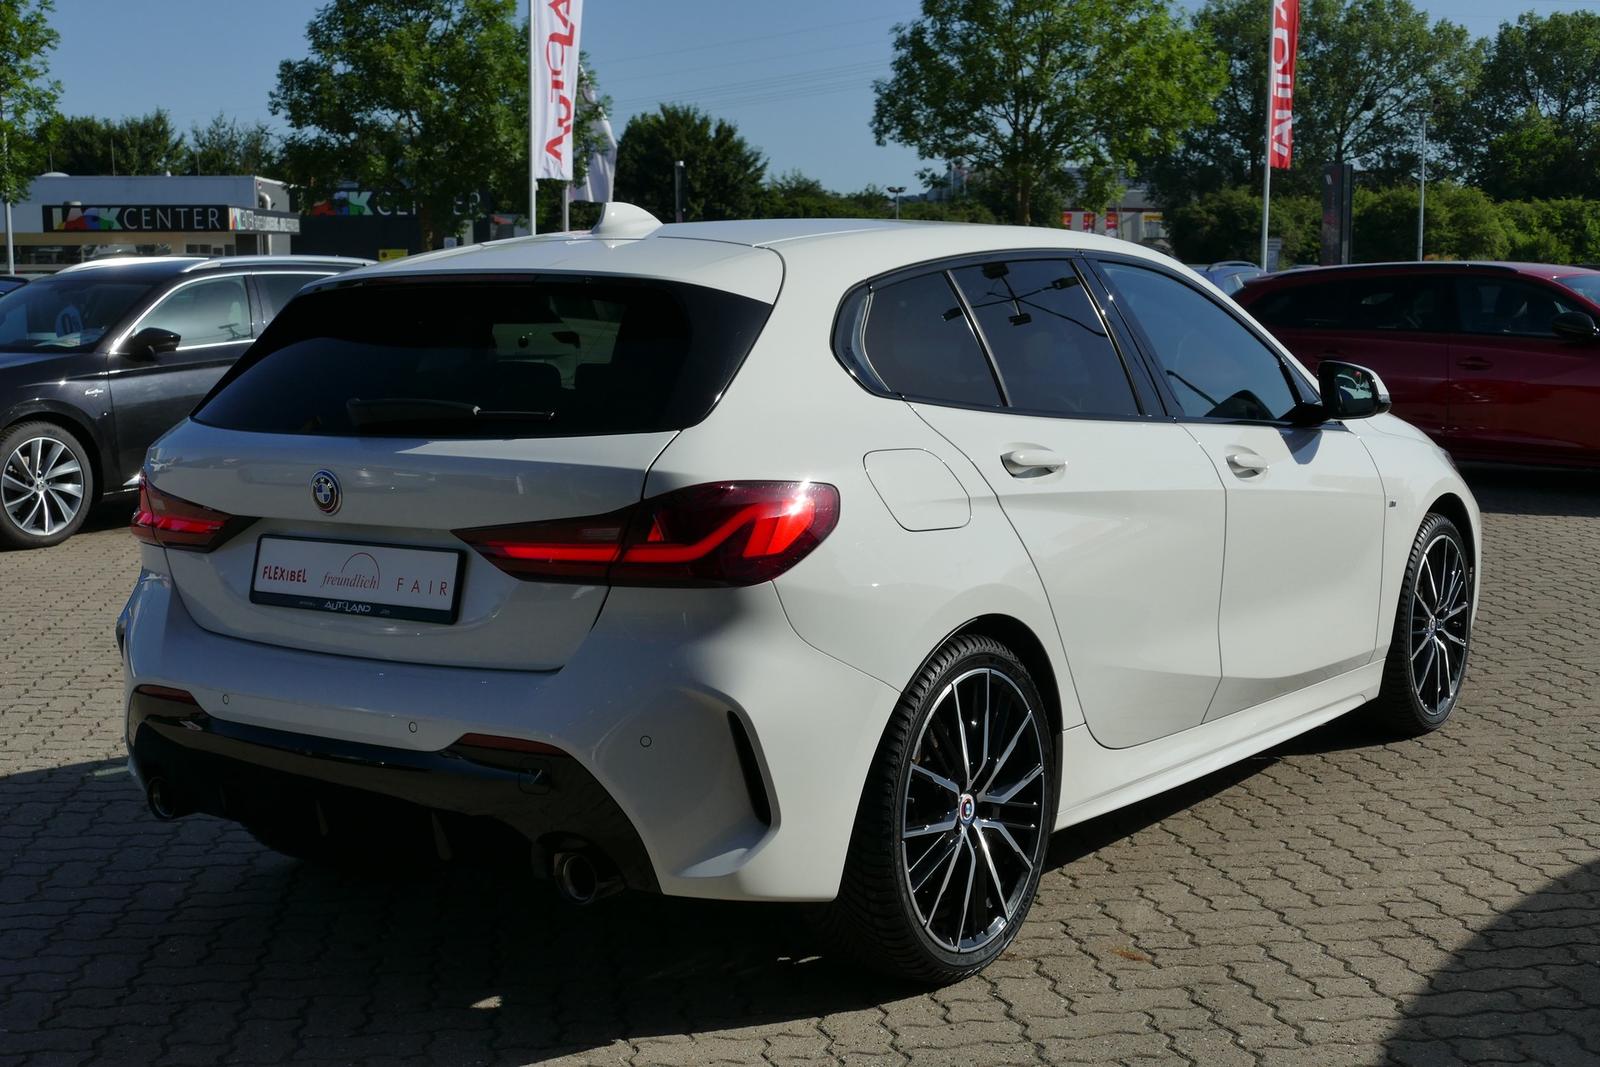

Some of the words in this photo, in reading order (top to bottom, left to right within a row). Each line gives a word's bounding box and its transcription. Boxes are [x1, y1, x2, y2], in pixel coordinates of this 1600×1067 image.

[262, 565, 308, 584] FLEXIBEL
[320, 571, 379, 590] freundlich
[396, 577, 448, 597] FAIR
